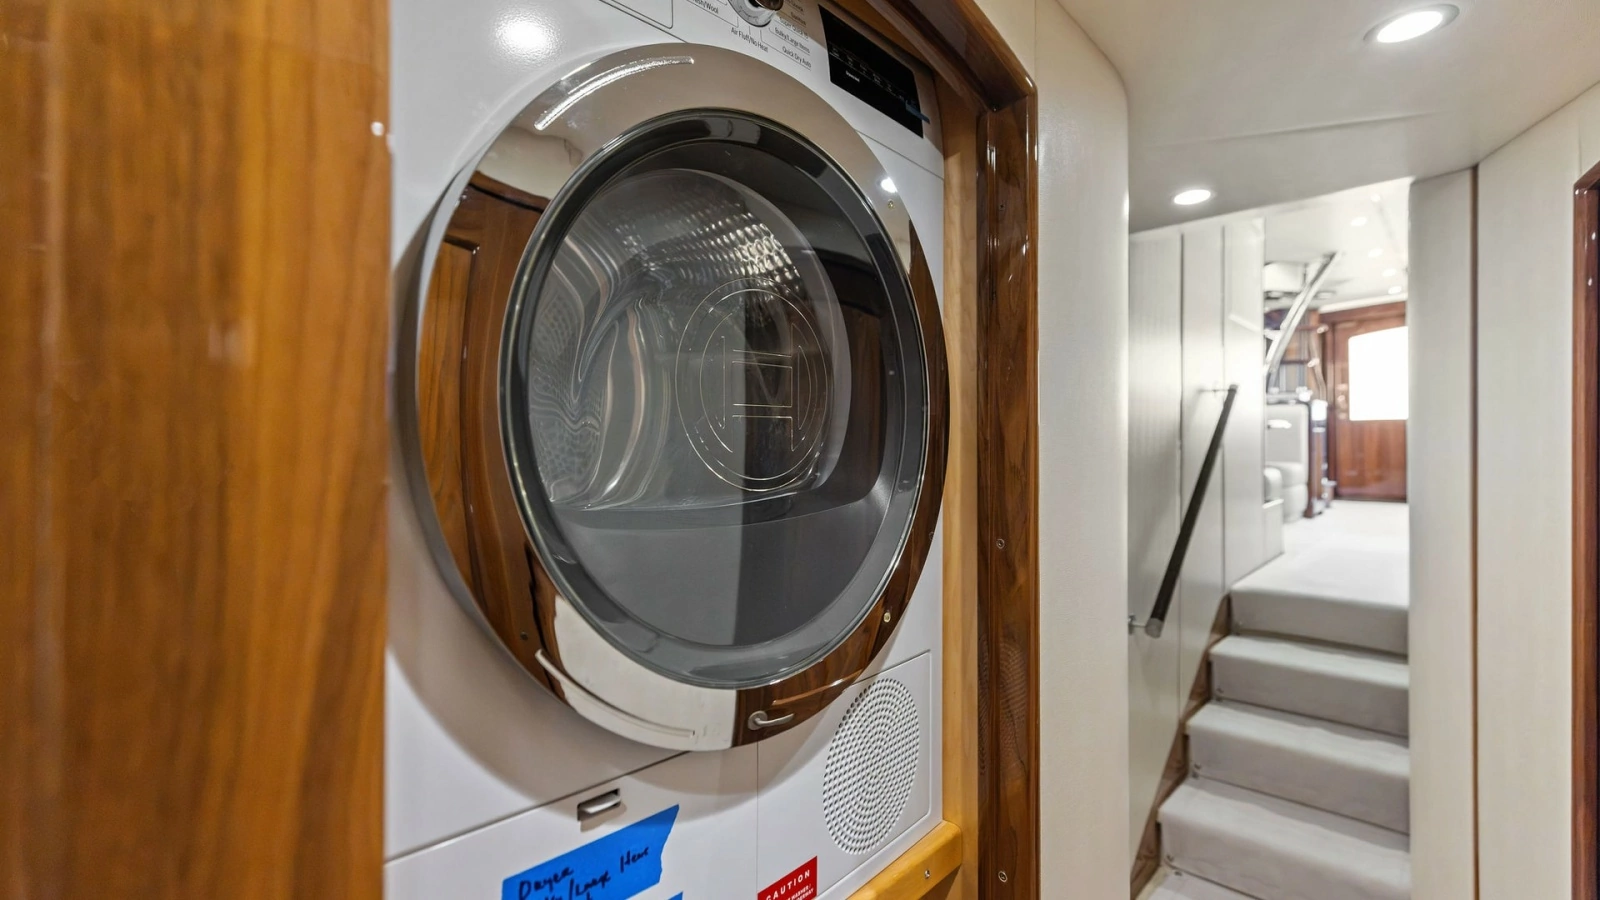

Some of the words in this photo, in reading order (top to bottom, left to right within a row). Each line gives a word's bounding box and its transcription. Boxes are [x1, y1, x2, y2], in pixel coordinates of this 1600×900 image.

[757, 42, 769, 53] Heat
[782, 46, 795, 58] Quick
[802, 58, 812, 68] Auto
[765, 869, 811, 900] CAUTION
